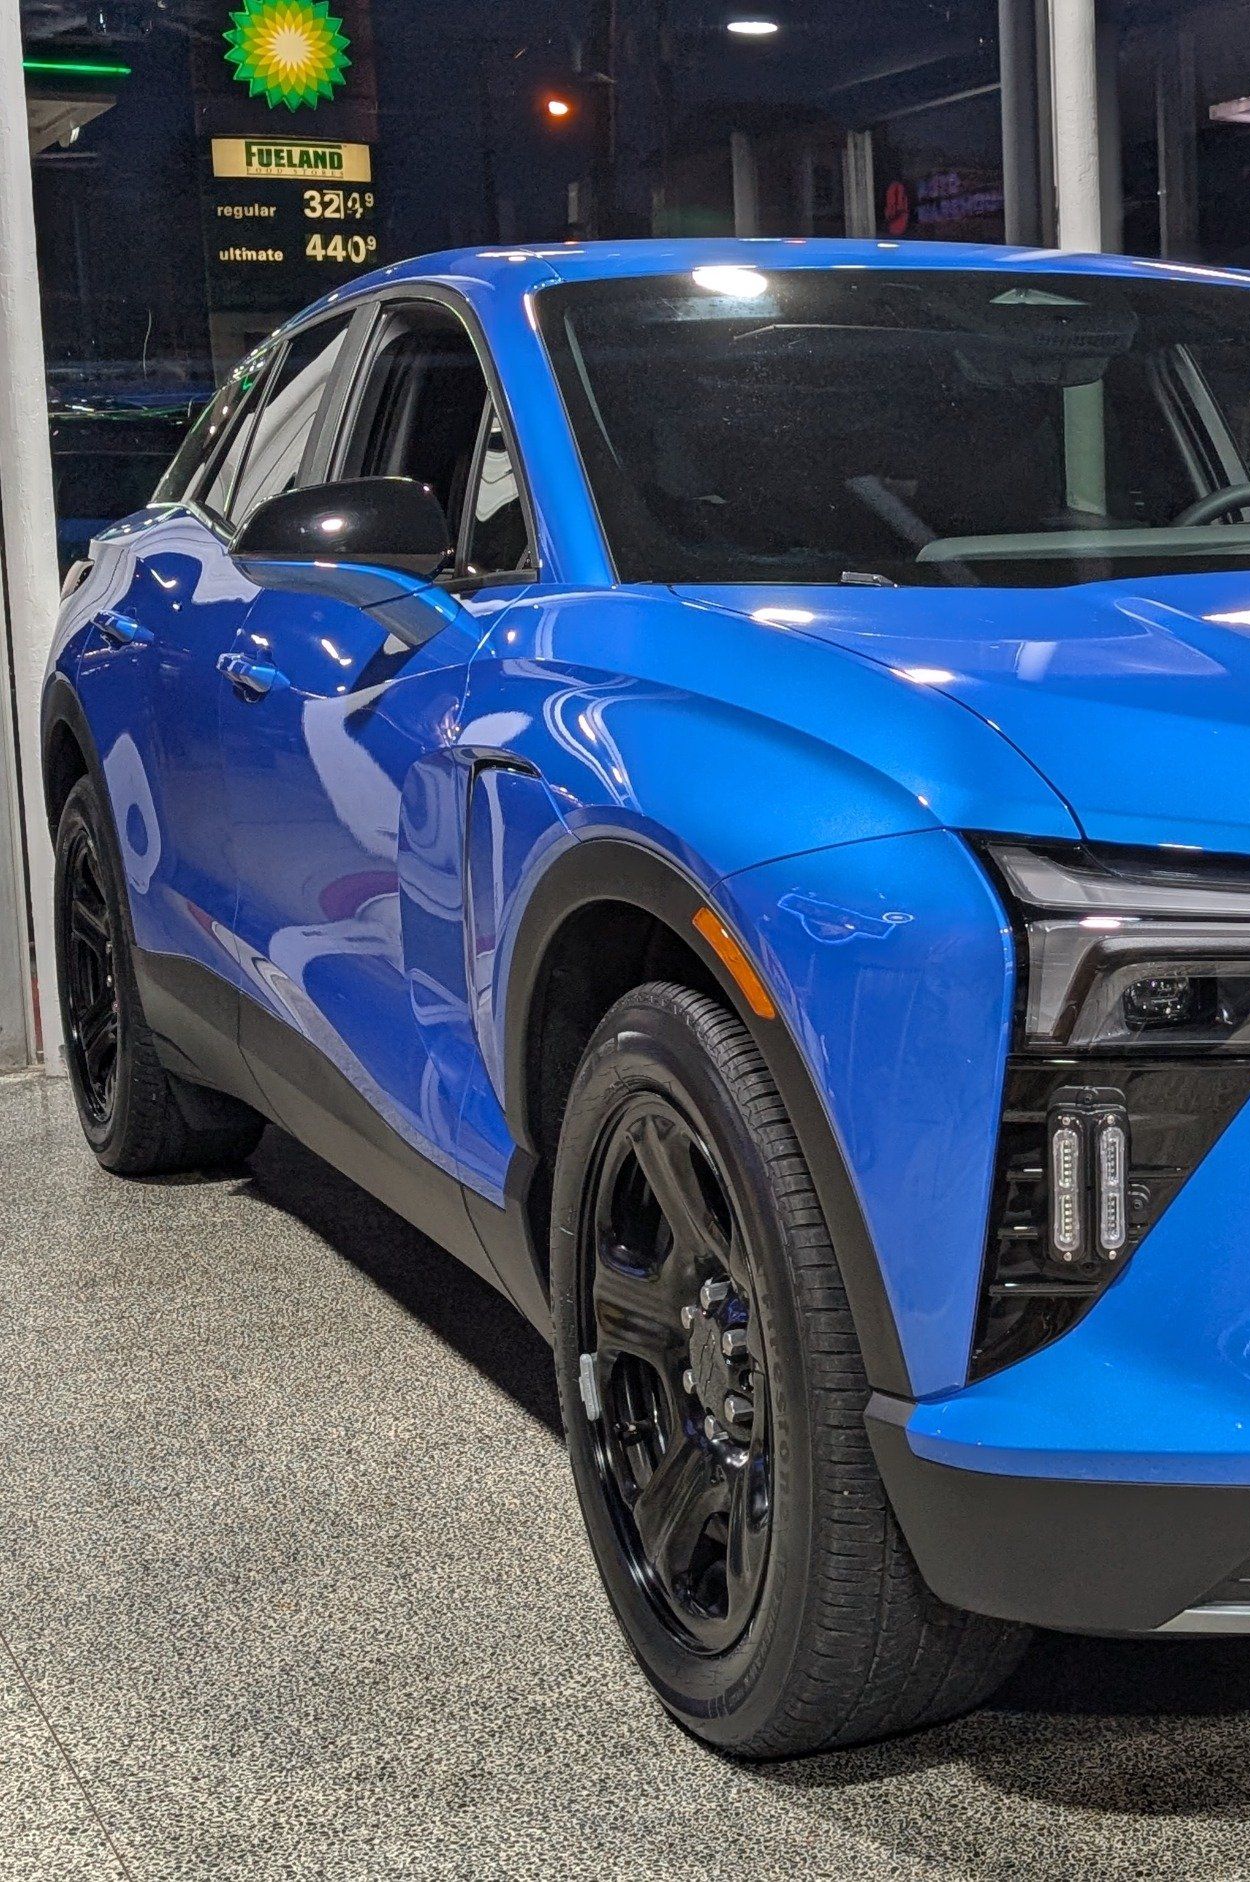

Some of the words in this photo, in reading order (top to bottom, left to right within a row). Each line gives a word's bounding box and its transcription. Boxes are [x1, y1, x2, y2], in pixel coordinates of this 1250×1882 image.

[245, 141, 344, 170] FUELAND
[217, 203, 277, 219] regular
[219, 247, 284, 261] ultimate
